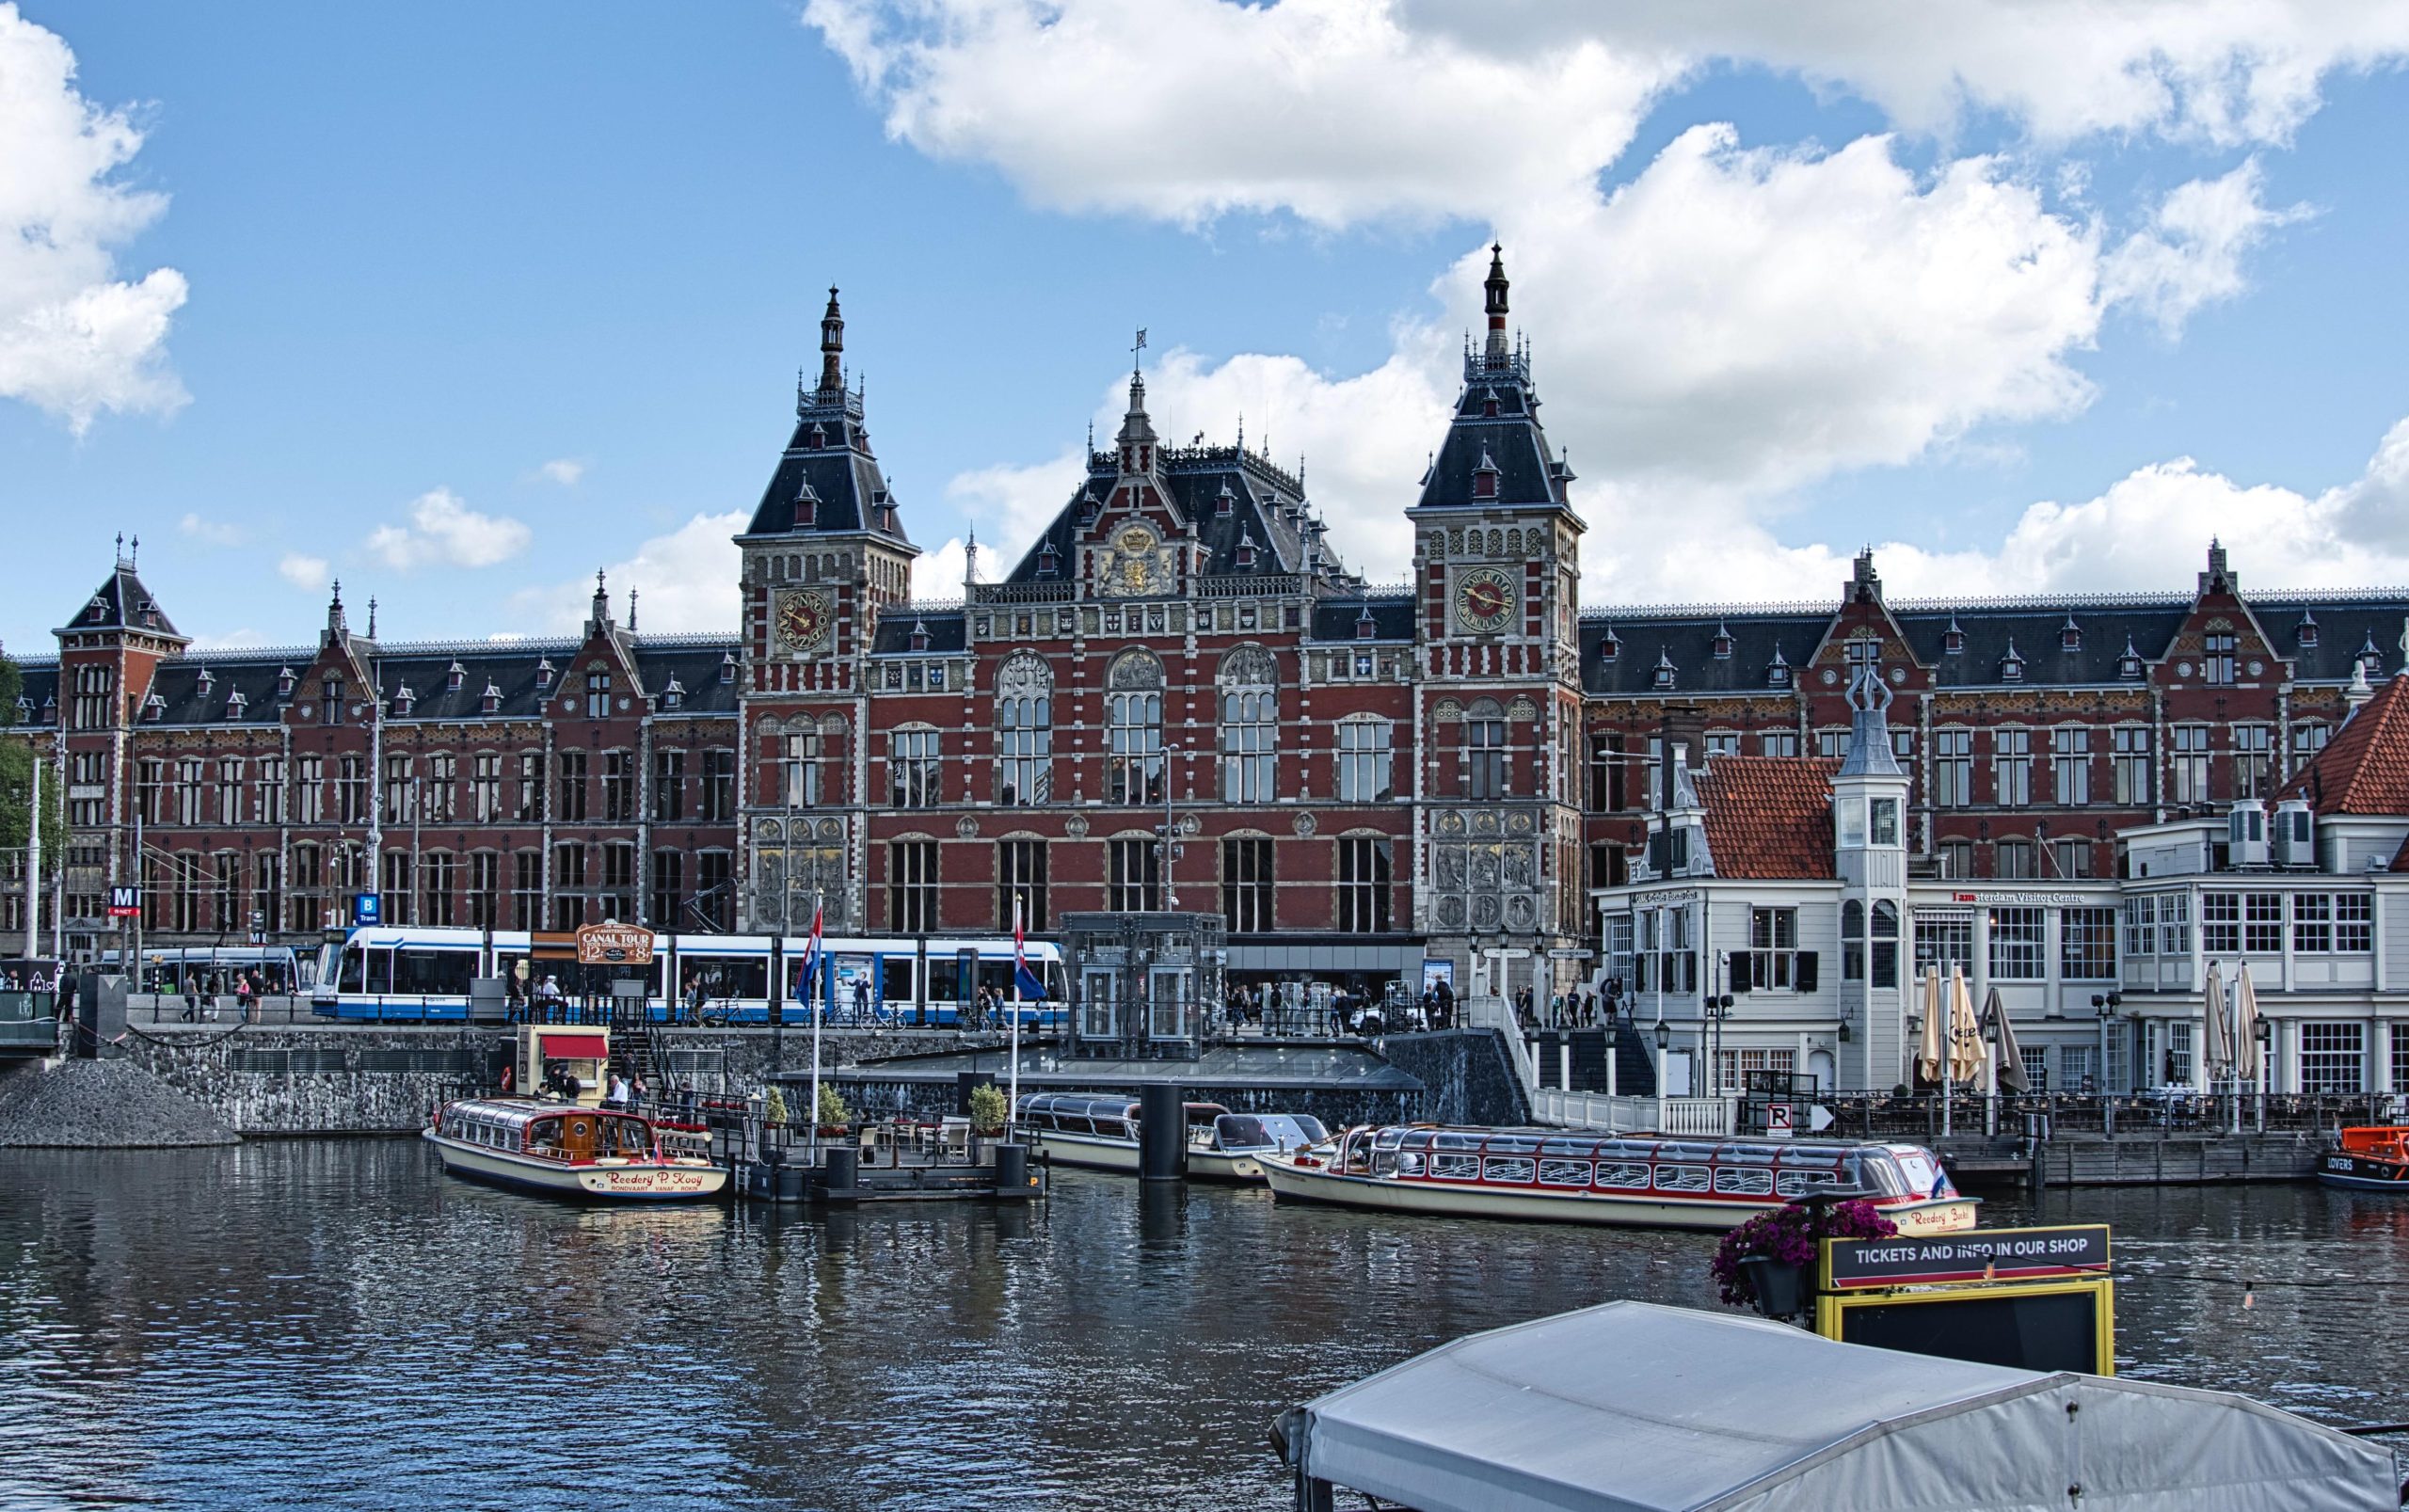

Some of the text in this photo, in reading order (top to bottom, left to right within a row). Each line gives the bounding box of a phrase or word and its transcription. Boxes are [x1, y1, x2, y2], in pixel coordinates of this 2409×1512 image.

[1953, 892, 1956, 902] I
[2018, 892, 2050, 902] Visitor
[2052, 892, 2085, 903] Centre
[363, 899, 373, 912] B
[582, 933, 649, 944] CANAL TOUR
[2327, 1156, 2353, 1171] LOVERS
[1856, 1237, 2088, 1264] TICKETS AND INFO IN OUR SHOP
